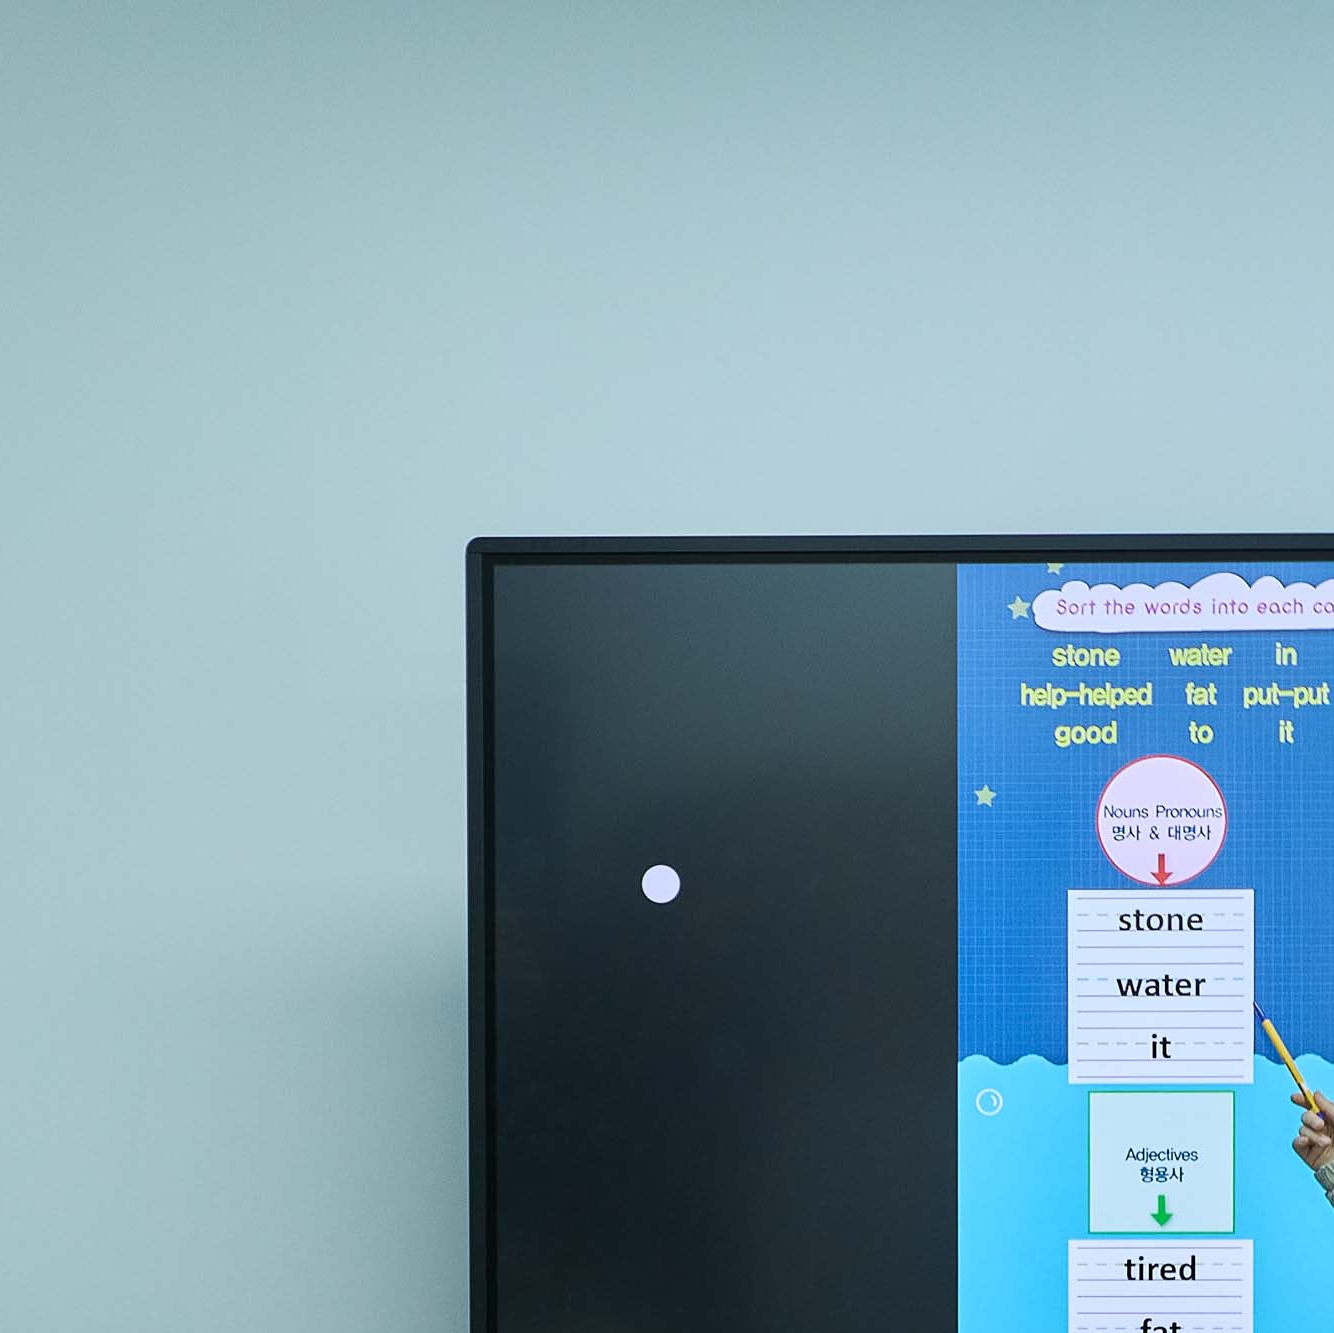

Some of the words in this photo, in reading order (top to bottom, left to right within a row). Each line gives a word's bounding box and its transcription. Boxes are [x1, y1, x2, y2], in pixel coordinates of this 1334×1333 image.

[1056, 597, 1097, 617] Sort
[1105, 597, 1136, 616] the
[1145, 597, 1202, 616] words
[1211, 597, 1248, 616] into
[1256, 597, 1304, 616] each
[1052, 644, 1120, 667] stone
[1169, 644, 1232, 667] water
[1275, 643, 1298, 666] in
[1020, 682, 1152, 709] help-helped
[1185, 681, 1217, 706] fat
[1243, 683, 1330, 709] put-put
[1055, 721, 1118, 748] good
[1189, 721, 1214, 745] to
[1278, 720, 1294, 744] it
[1103, 804, 1149, 819] Nouns
[1155, 803, 1225, 819] Pronouns
[1112, 824, 1141, 842] 명사
[1149, 825, 1160, 841] &
[1168, 824, 1212, 842] 대명사
[1118, 909, 1204, 932] stone
[1116, 974, 1206, 997] water
[1150, 1033, 1171, 1059] it
[1125, 1147, 1199, 1165] Adjectives
[1140, 1166, 1184, 1184] 형용사
[1124, 1254, 1197, 1282] tired
